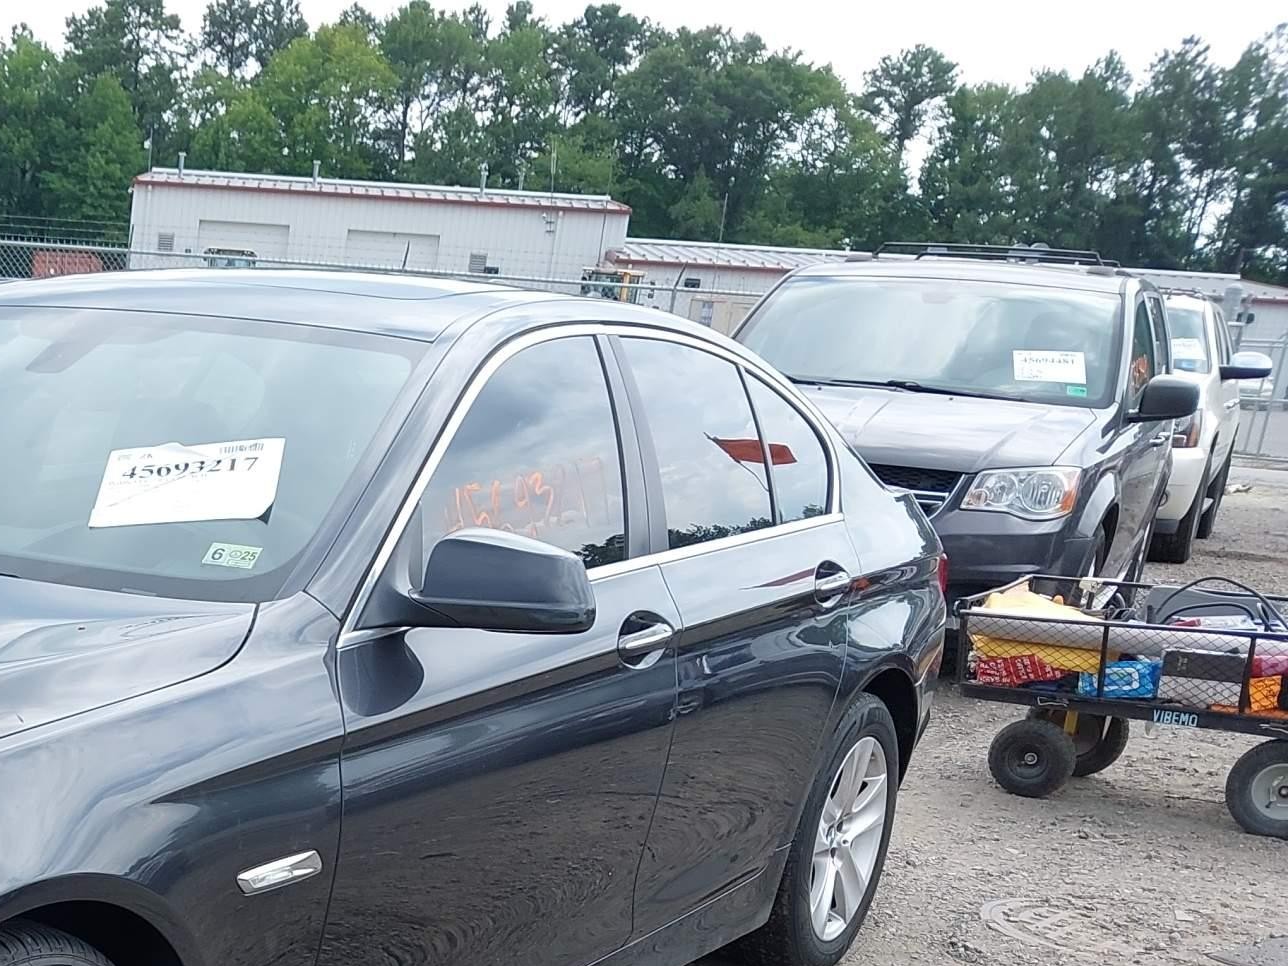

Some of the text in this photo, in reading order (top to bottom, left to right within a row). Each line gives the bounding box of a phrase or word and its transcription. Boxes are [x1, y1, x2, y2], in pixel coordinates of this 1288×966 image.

[211, 548, 258, 561] 6 25
[1153, 709, 1199, 727] VIBEMO
